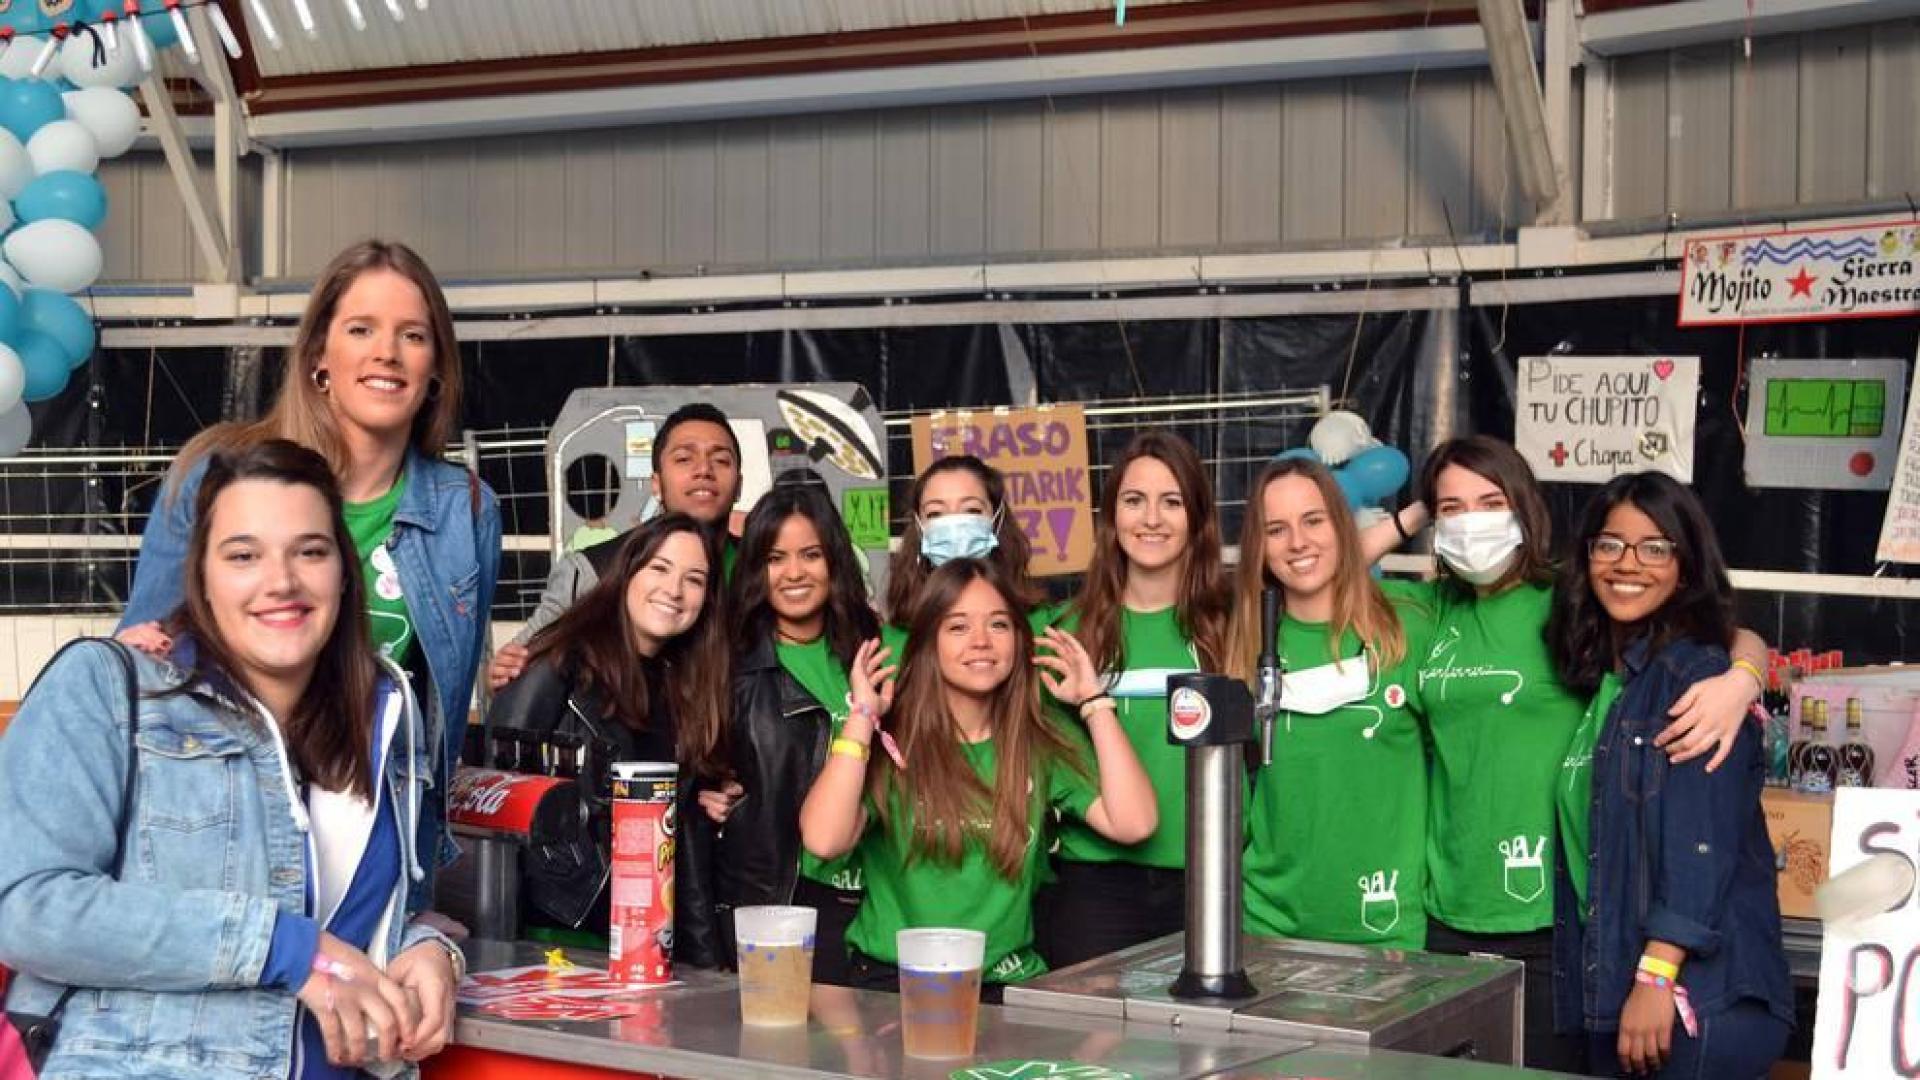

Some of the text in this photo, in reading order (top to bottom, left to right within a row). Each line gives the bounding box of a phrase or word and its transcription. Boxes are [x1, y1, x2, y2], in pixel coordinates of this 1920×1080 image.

[1831, 256, 1912, 286] Sierra
[1691, 268, 1772, 313] Mojito
[1528, 395, 1660, 428] TU CHUPITO
[1574, 438, 1634, 476] Chapa
[1003, 466, 1085, 505] TARIK
[1859, 821, 1920, 914] S
